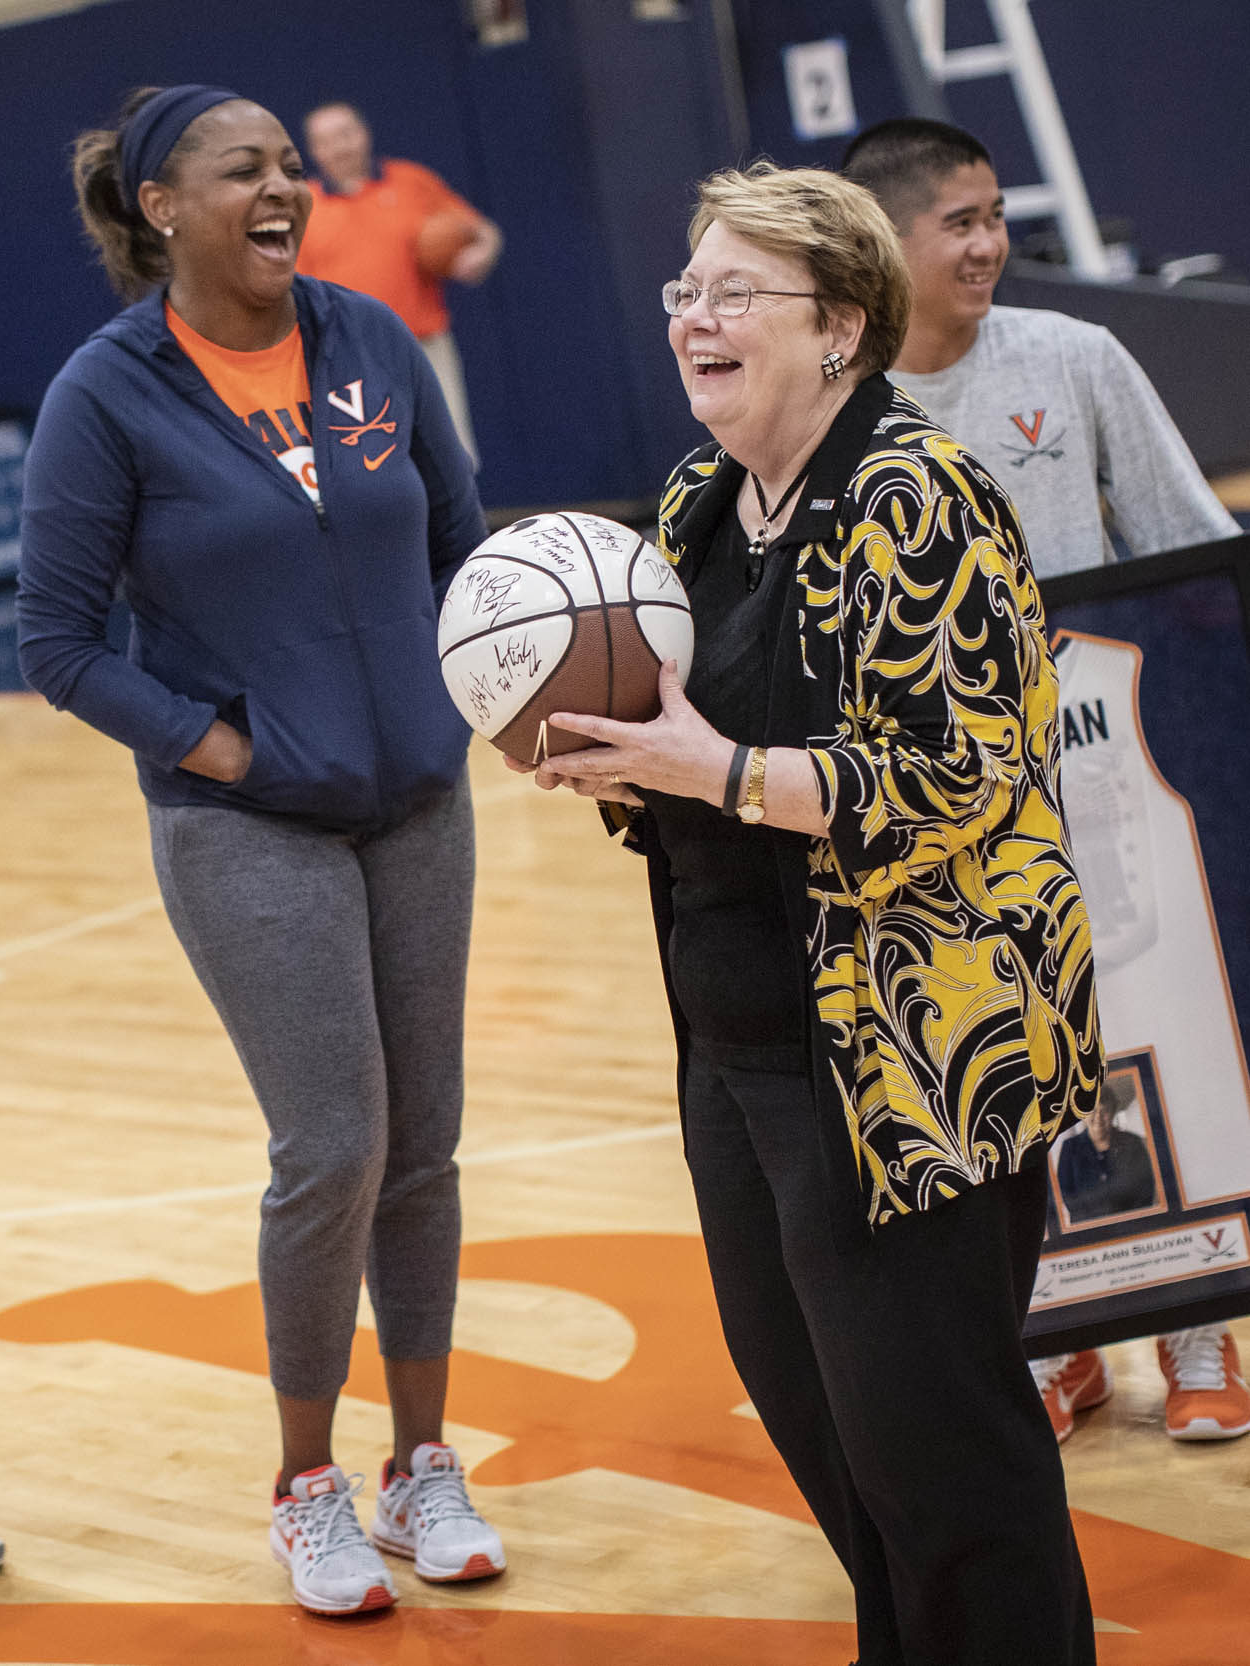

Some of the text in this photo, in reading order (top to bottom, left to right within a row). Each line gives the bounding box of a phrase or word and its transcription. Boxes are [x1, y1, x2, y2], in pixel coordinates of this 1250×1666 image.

[1050, 1234, 1193, 1273] TERESA ANN SULLIVAN
